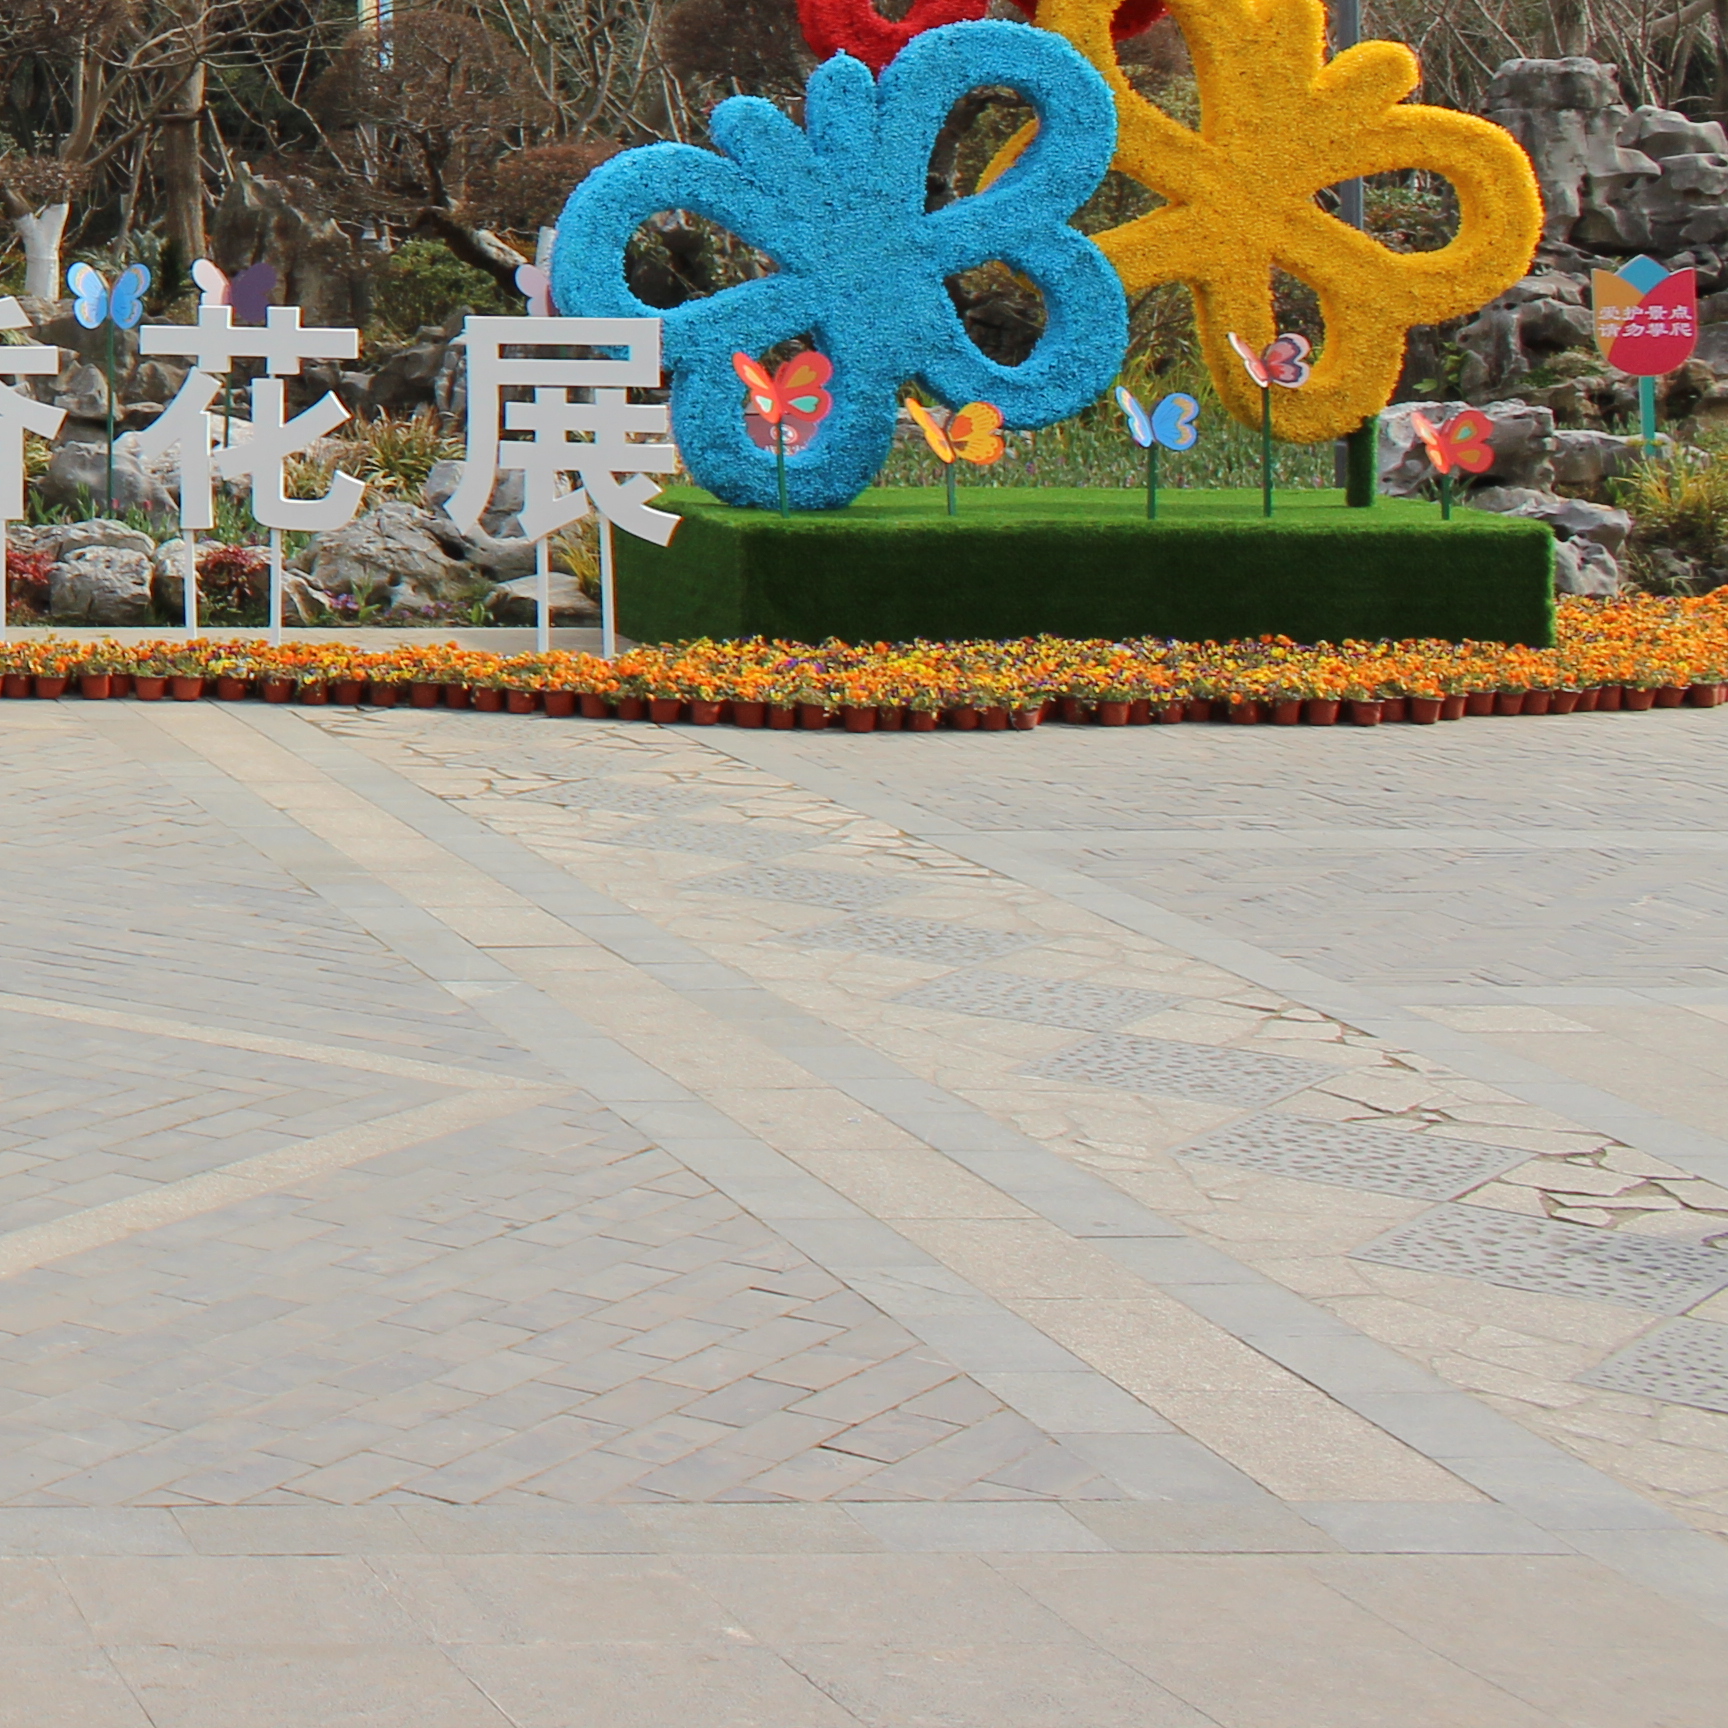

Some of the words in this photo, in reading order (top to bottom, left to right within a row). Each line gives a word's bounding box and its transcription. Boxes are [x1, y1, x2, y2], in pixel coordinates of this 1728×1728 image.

[1598, 305, 1693, 320] 爱护景点
[1598, 323, 1693, 337] 请勿攀爬
